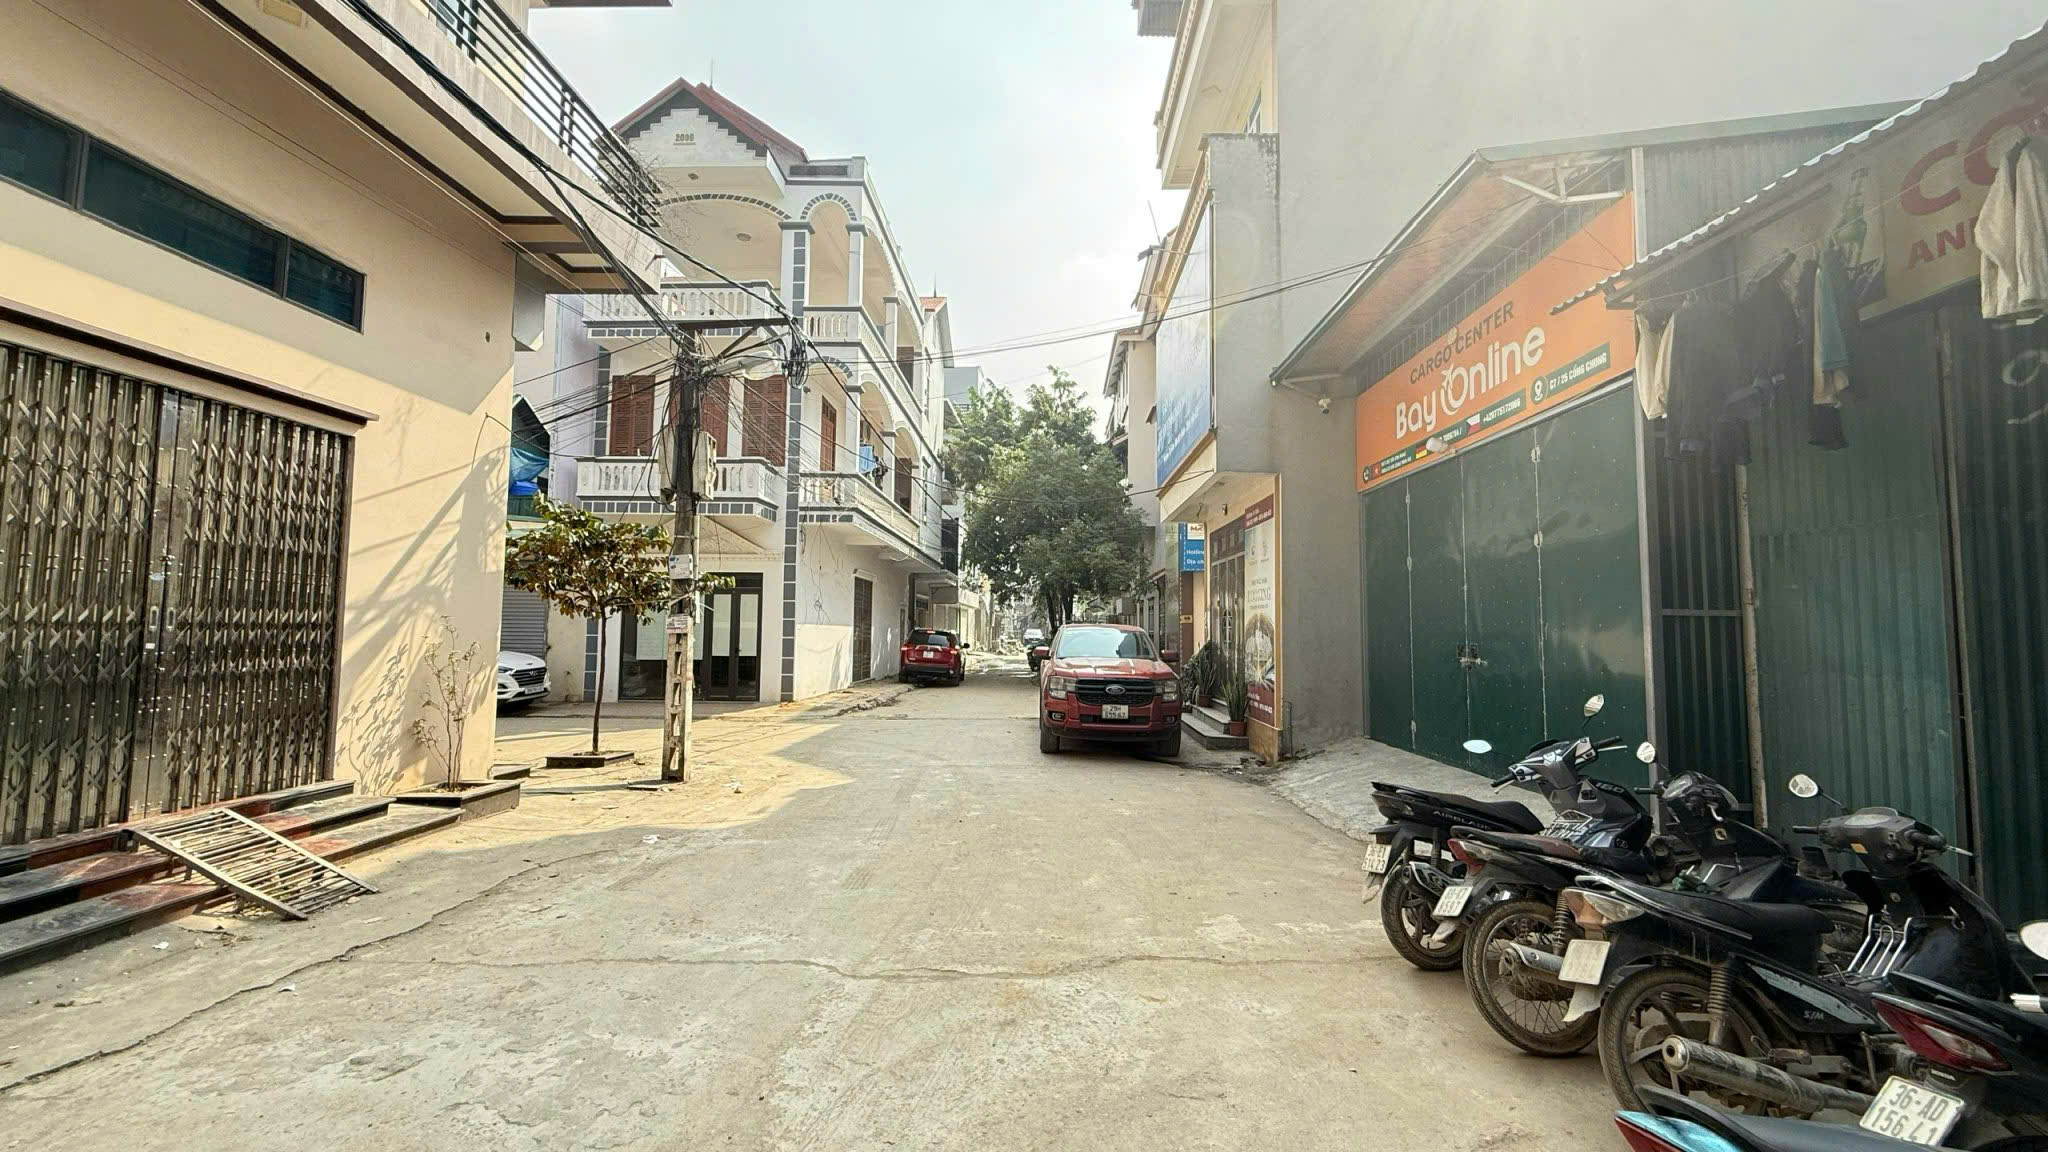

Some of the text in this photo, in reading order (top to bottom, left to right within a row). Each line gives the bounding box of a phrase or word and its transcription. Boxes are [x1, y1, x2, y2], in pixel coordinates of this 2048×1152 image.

[1395, 326, 1546, 439] Bay Online
[1410, 301, 1514, 384] CARGO CENTER
[1888, 1085, 1949, 1122] 36-AD
